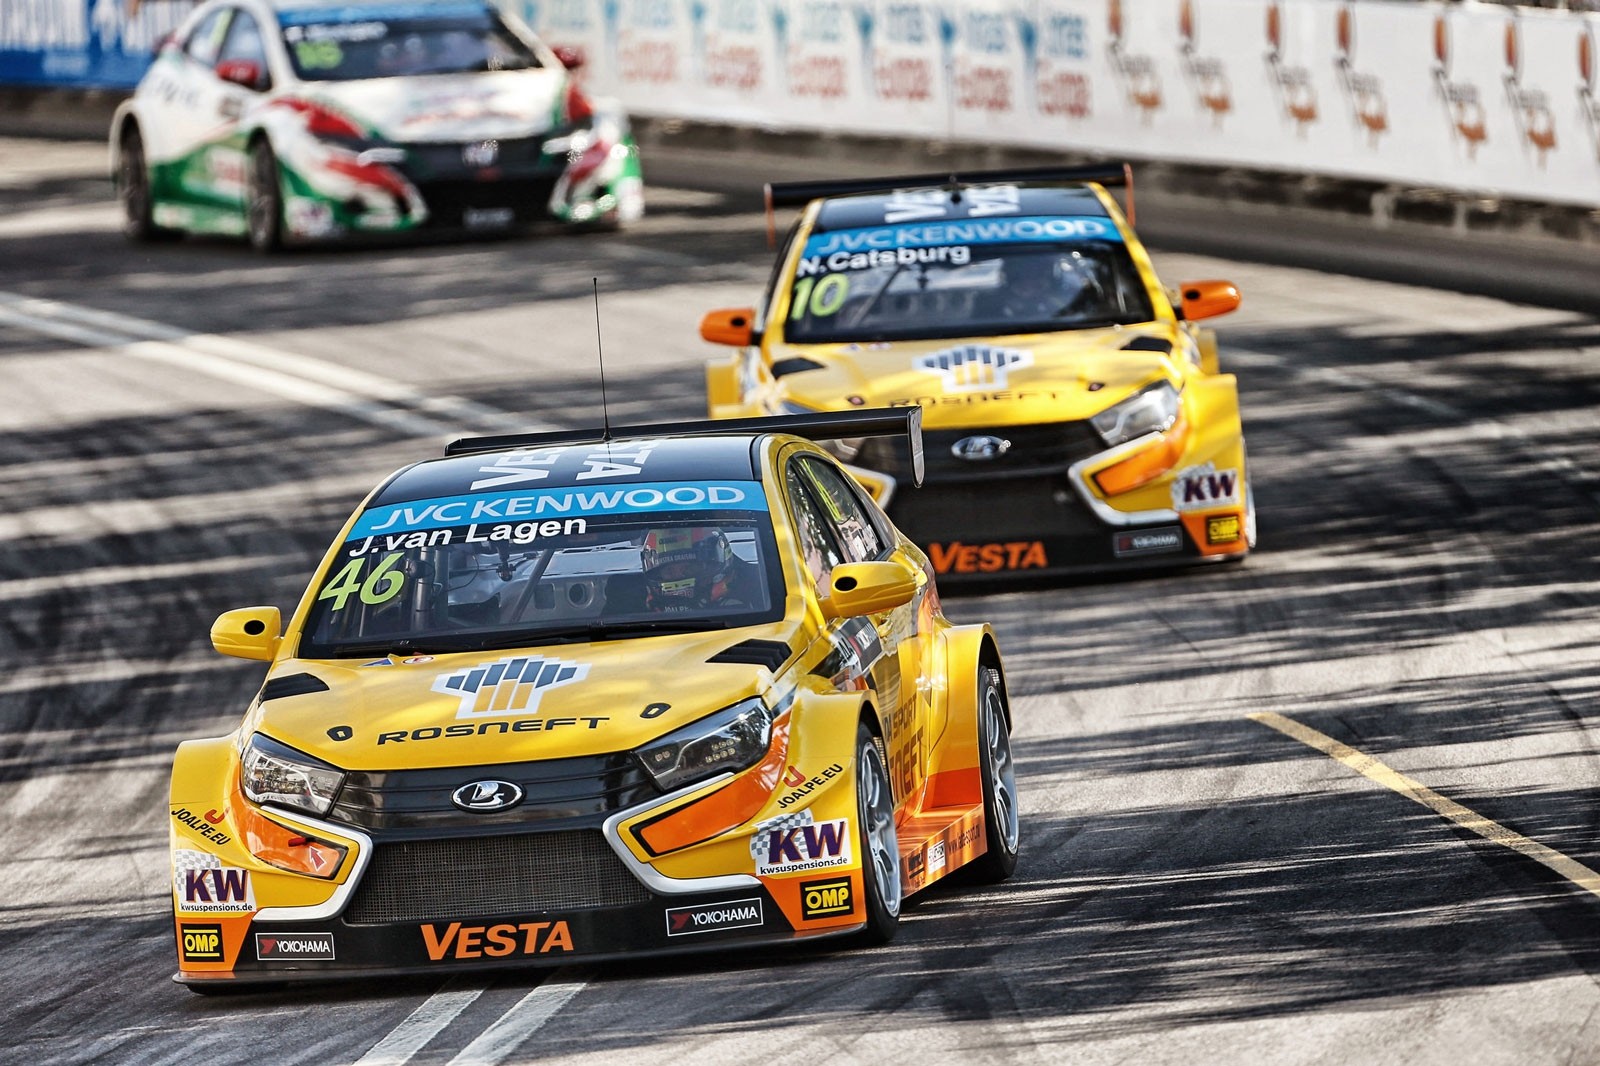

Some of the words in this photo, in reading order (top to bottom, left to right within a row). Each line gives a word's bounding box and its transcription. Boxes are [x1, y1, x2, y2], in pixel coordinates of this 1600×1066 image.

[820, 229, 891, 251] JVC
[896, 219, 1107, 244] KENWOOD
[796, 245, 971, 276] N.Catsburg
[791, 273, 848, 320] 10
[1184, 473, 1237, 503] KW
[370, 502, 467, 530] JVC
[470, 486, 745, 519] KENWOOD
[349, 529, 453, 557] J.van
[465, 518, 587, 545] Lagen
[930, 541, 1047, 574] VESTA
[318, 552, 405, 612] 46
[377, 717, 611, 745] ROSNEFT
[894, 692, 917, 739] SPORT
[777, 763, 843, 809] JOALPE.EU
[171, 808, 231, 846] JOALPE.EU
[768, 821, 846, 864] KW
[760, 857, 848, 875] kwsuspensions.de
[185, 869, 249, 903] KW
[806, 887, 849, 909] OMP
[181, 903, 253, 912] kwsuspensions.de
[692, 906, 758, 926] YOKOHAMA
[184, 934, 219, 952] OMP
[276, 940, 331, 953] YOKOHAMA
[420, 921, 574, 960] VESTA
